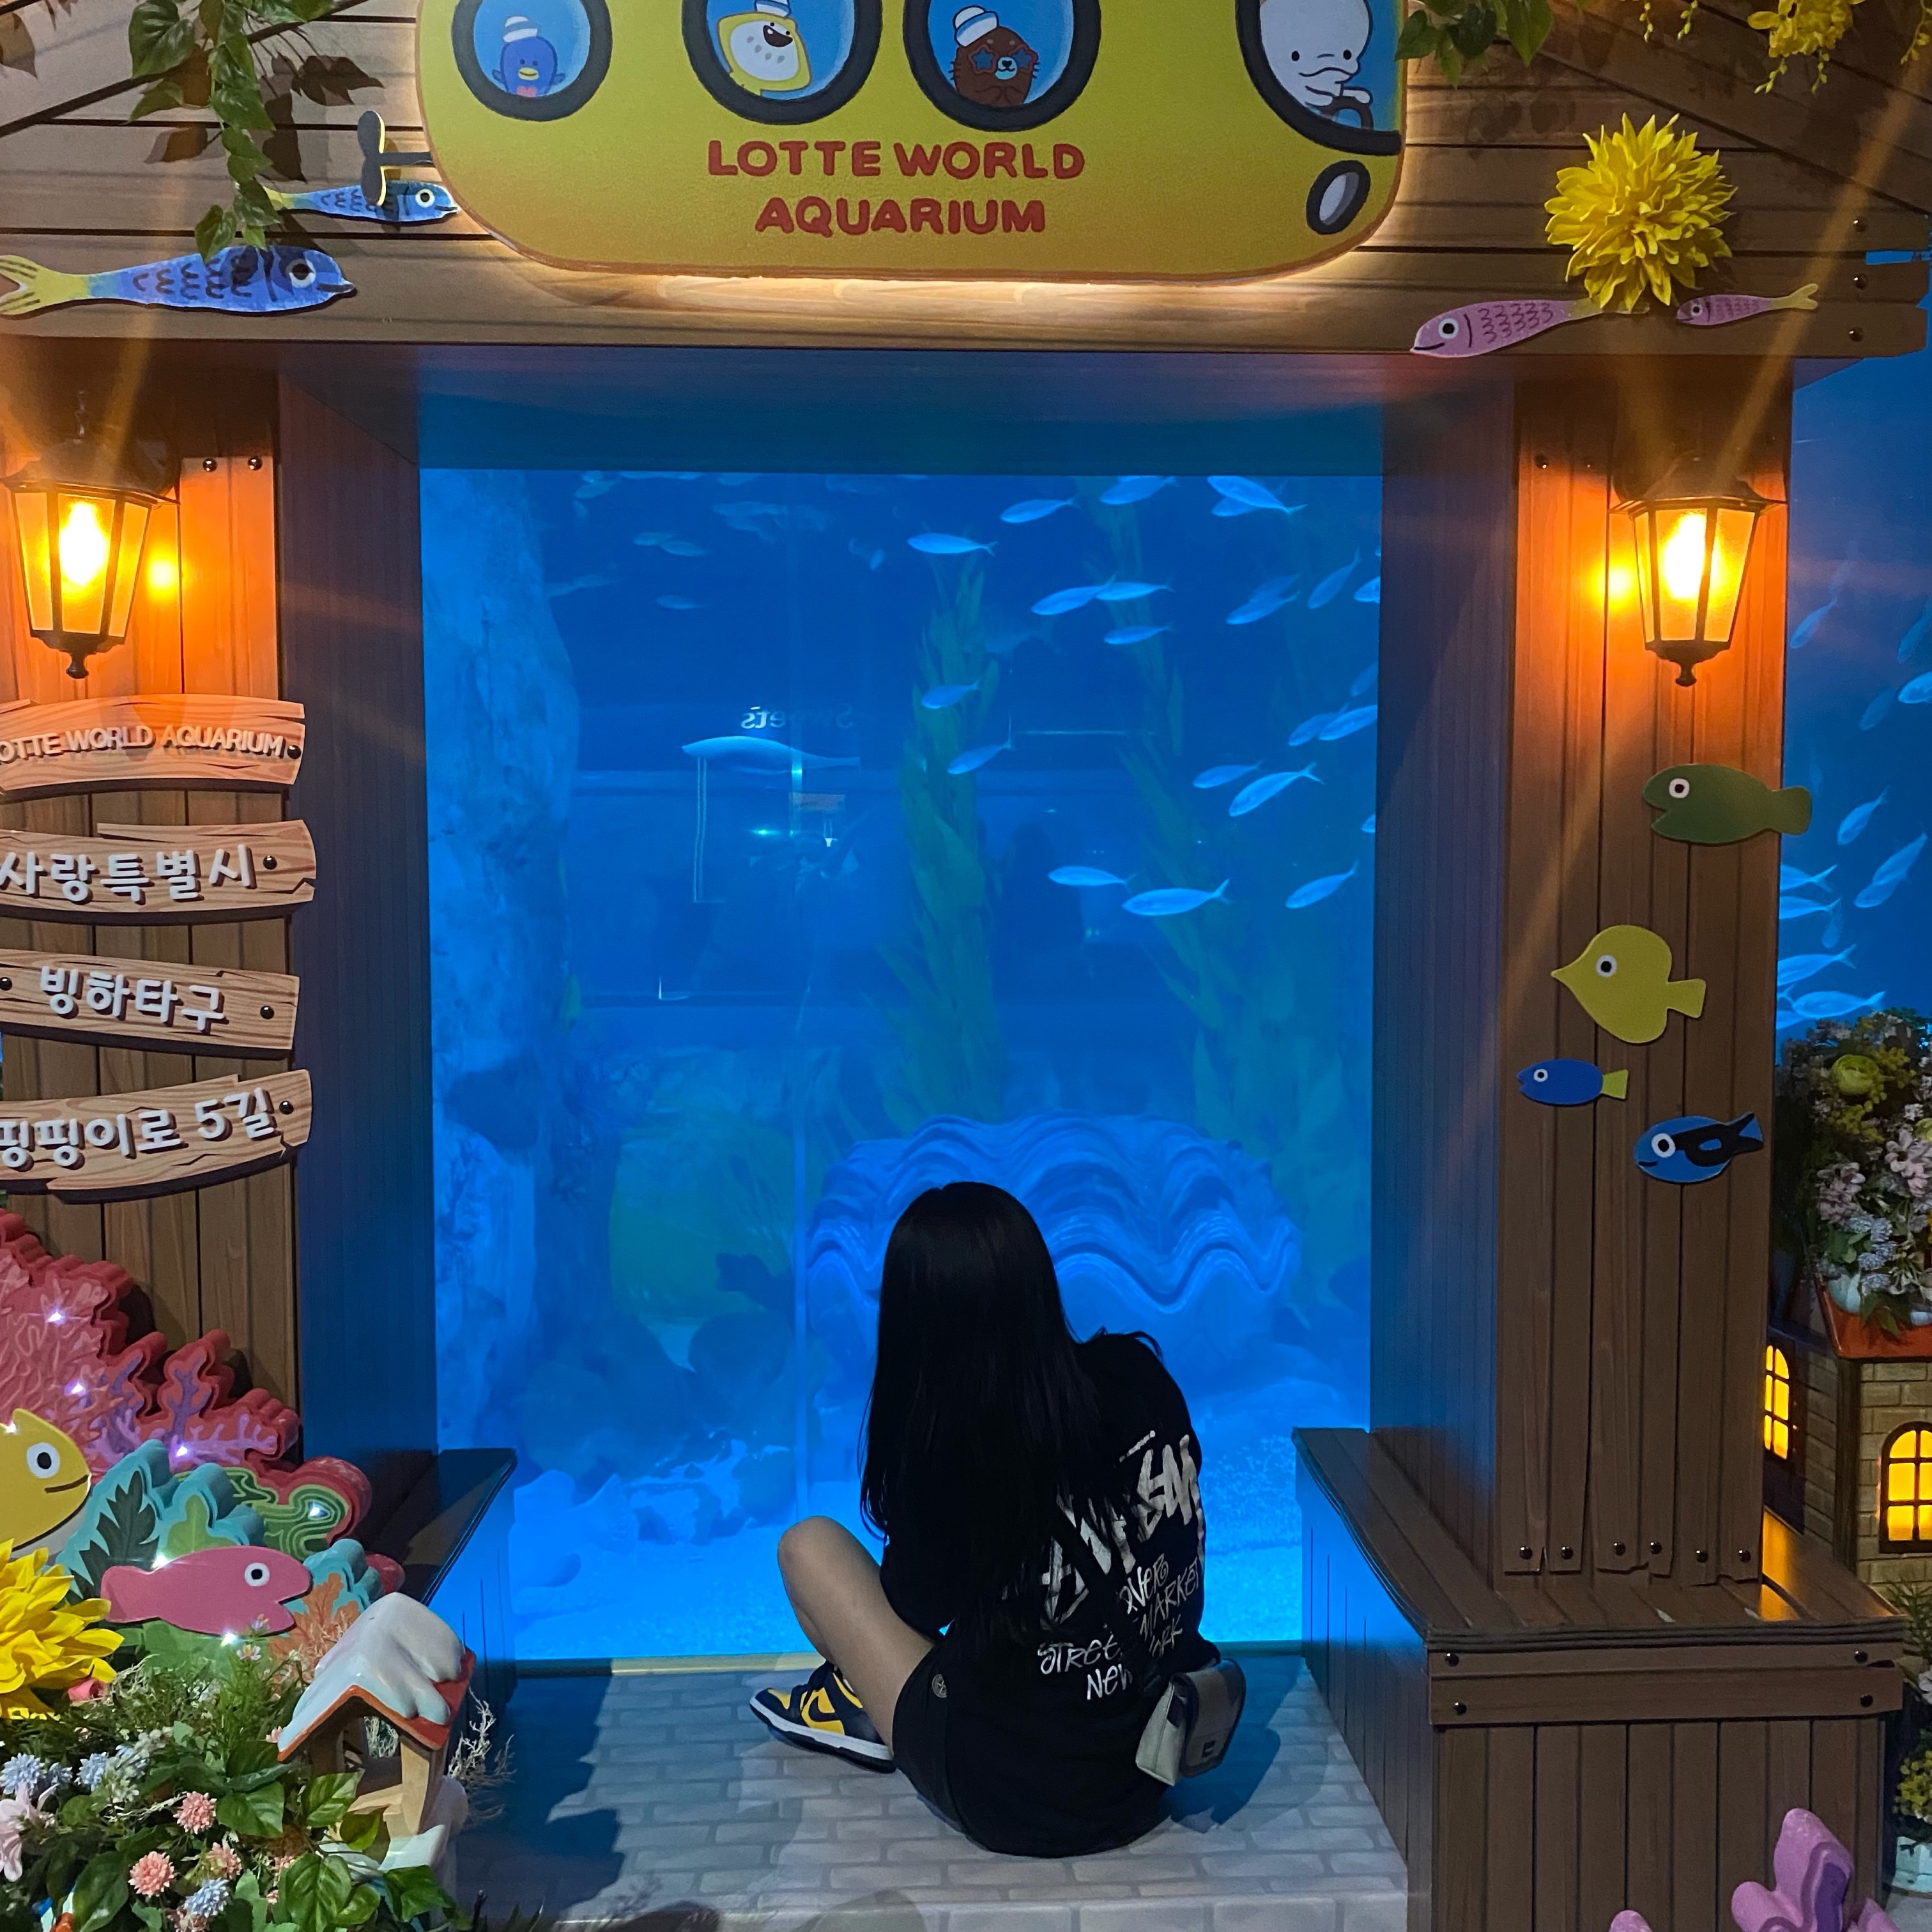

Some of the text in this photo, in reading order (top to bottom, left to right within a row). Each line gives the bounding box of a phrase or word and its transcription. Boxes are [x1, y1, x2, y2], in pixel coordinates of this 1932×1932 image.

[708, 140, 1085, 180] LOTTE WORLD
[755, 195, 1046, 238] AQUARIUM
[0, 724, 285, 762] OTTE WORLD AQUARIUM
[0, 844, 257, 903] 사랑특별시
[40, 965, 226, 1031] 빙하타구
[194, 1087, 276, 1140] 5길
